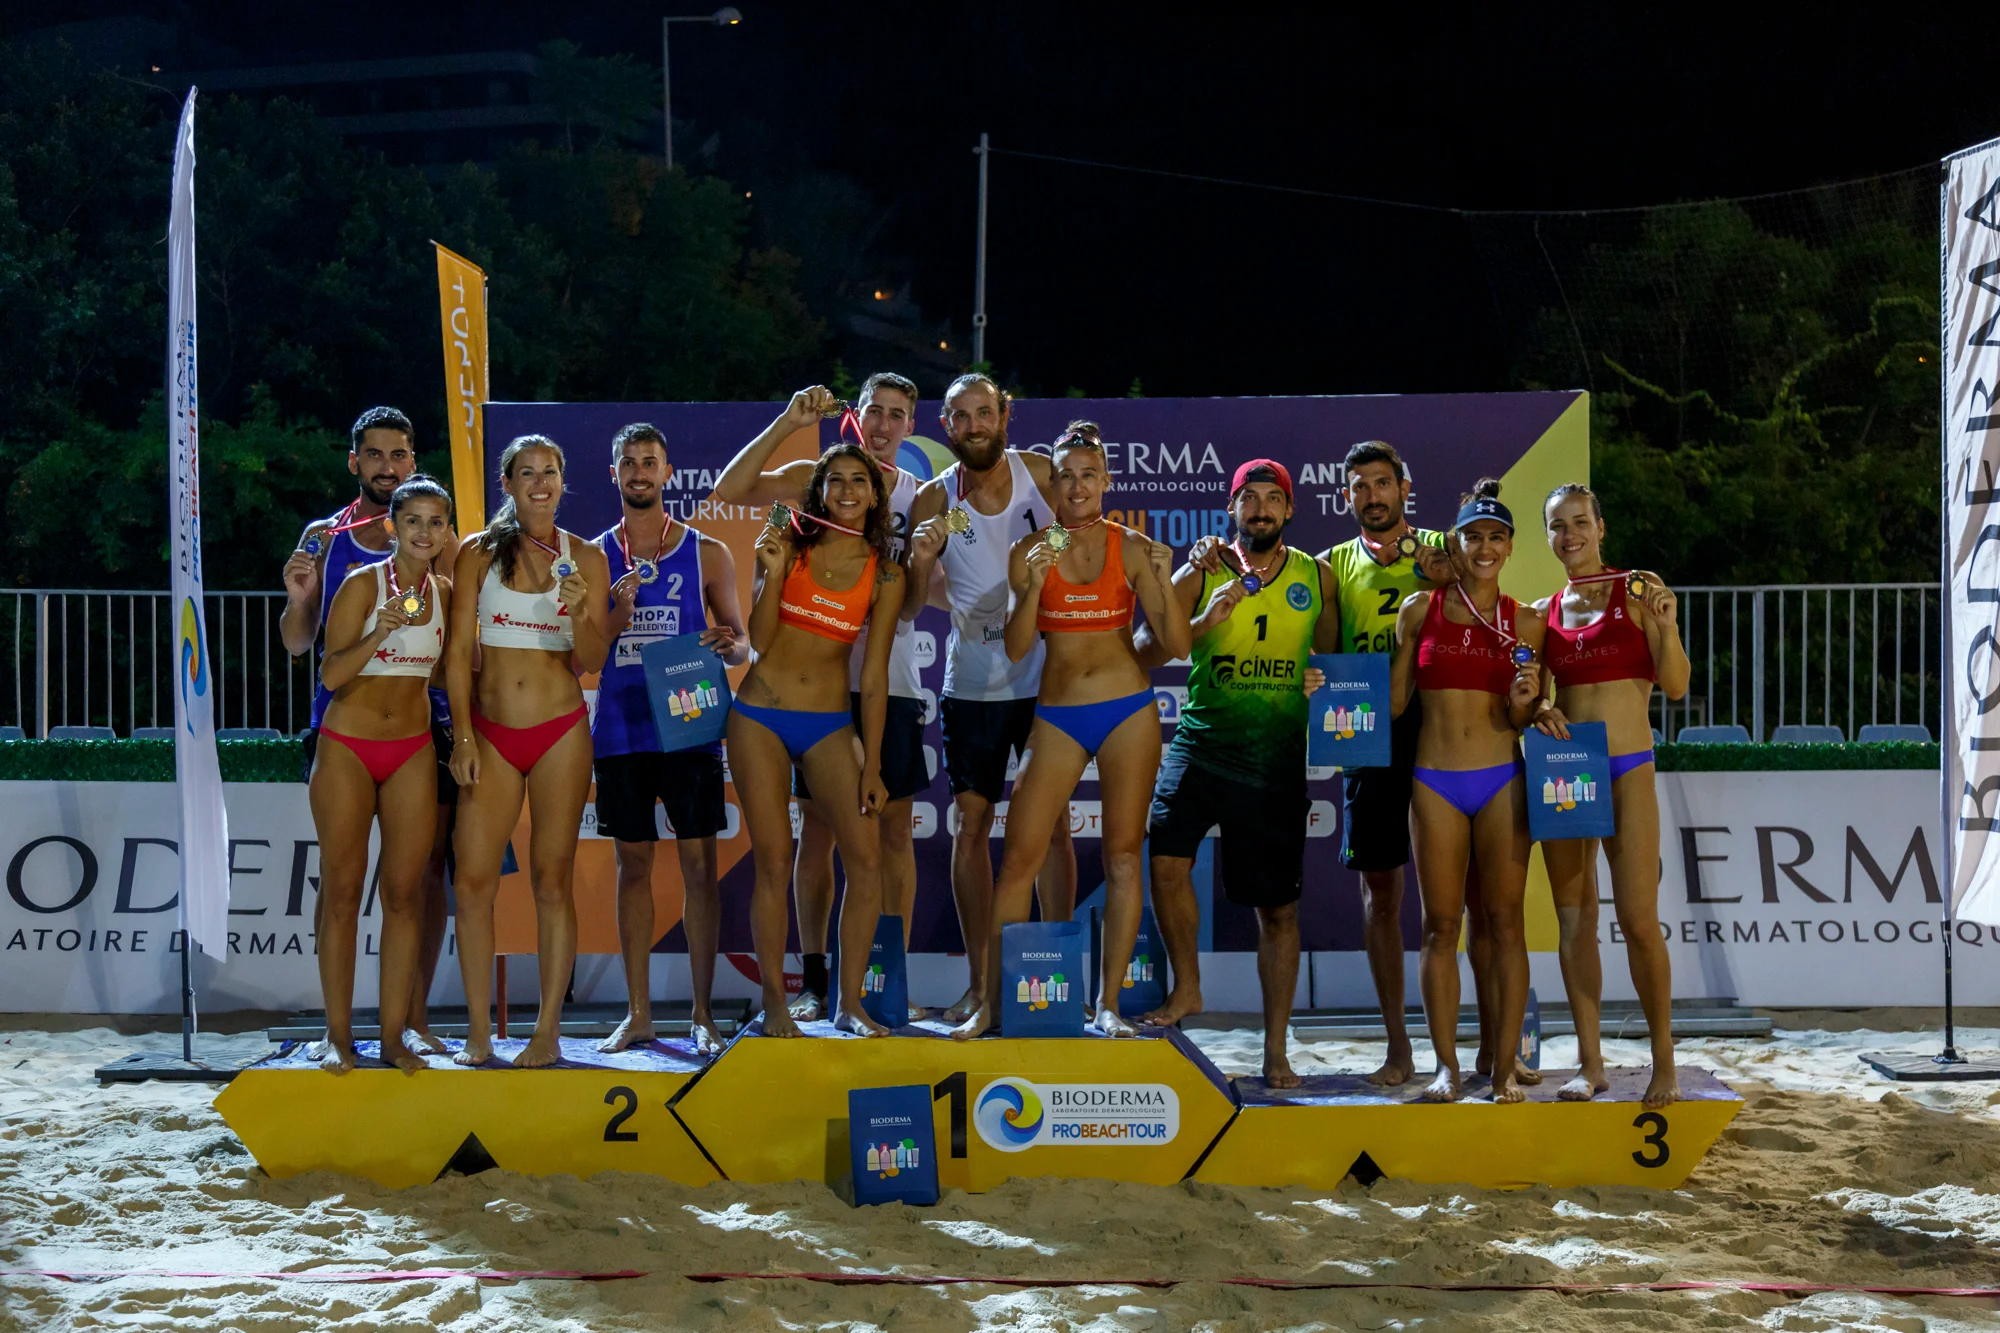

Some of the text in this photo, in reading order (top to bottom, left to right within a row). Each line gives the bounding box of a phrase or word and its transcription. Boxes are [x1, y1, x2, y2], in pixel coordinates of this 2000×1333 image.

[1108, 481, 1226, 493] RMATOLOGIQUE
[1022, 508, 1038, 533] 1
[666, 572, 684, 601] 2
[1378, 588, 1400, 616] 2
[633, 610, 677, 622] HOPA
[1613, 606, 1624, 620] 2
[508, 620, 561, 633] corendon
[1254, 614, 1268, 641] 1
[436, 627, 443, 648] 1
[1427, 643, 1505, 660] SOCRATES
[1555, 644, 1619, 667] OCRATES
[665, 660, 705, 673] BIODERMA
[1230, 682, 1300, 693] CONSTRUCTION
[1330, 681, 1370, 690] BIODERMA
[1546, 752, 1588, 761] BIODERMA
[1022, 952, 1063, 960] BIODERMA
[1052, 1090, 1165, 1106] BIODERMA
[604, 1086, 639, 1142] 2
[870, 1116, 912, 1125] BIODERMA
[934, 1071, 967, 1159] 1
[1052, 1123, 1167, 1139] PROBEACHTOUR
[1631, 1111, 1670, 1168] 3
